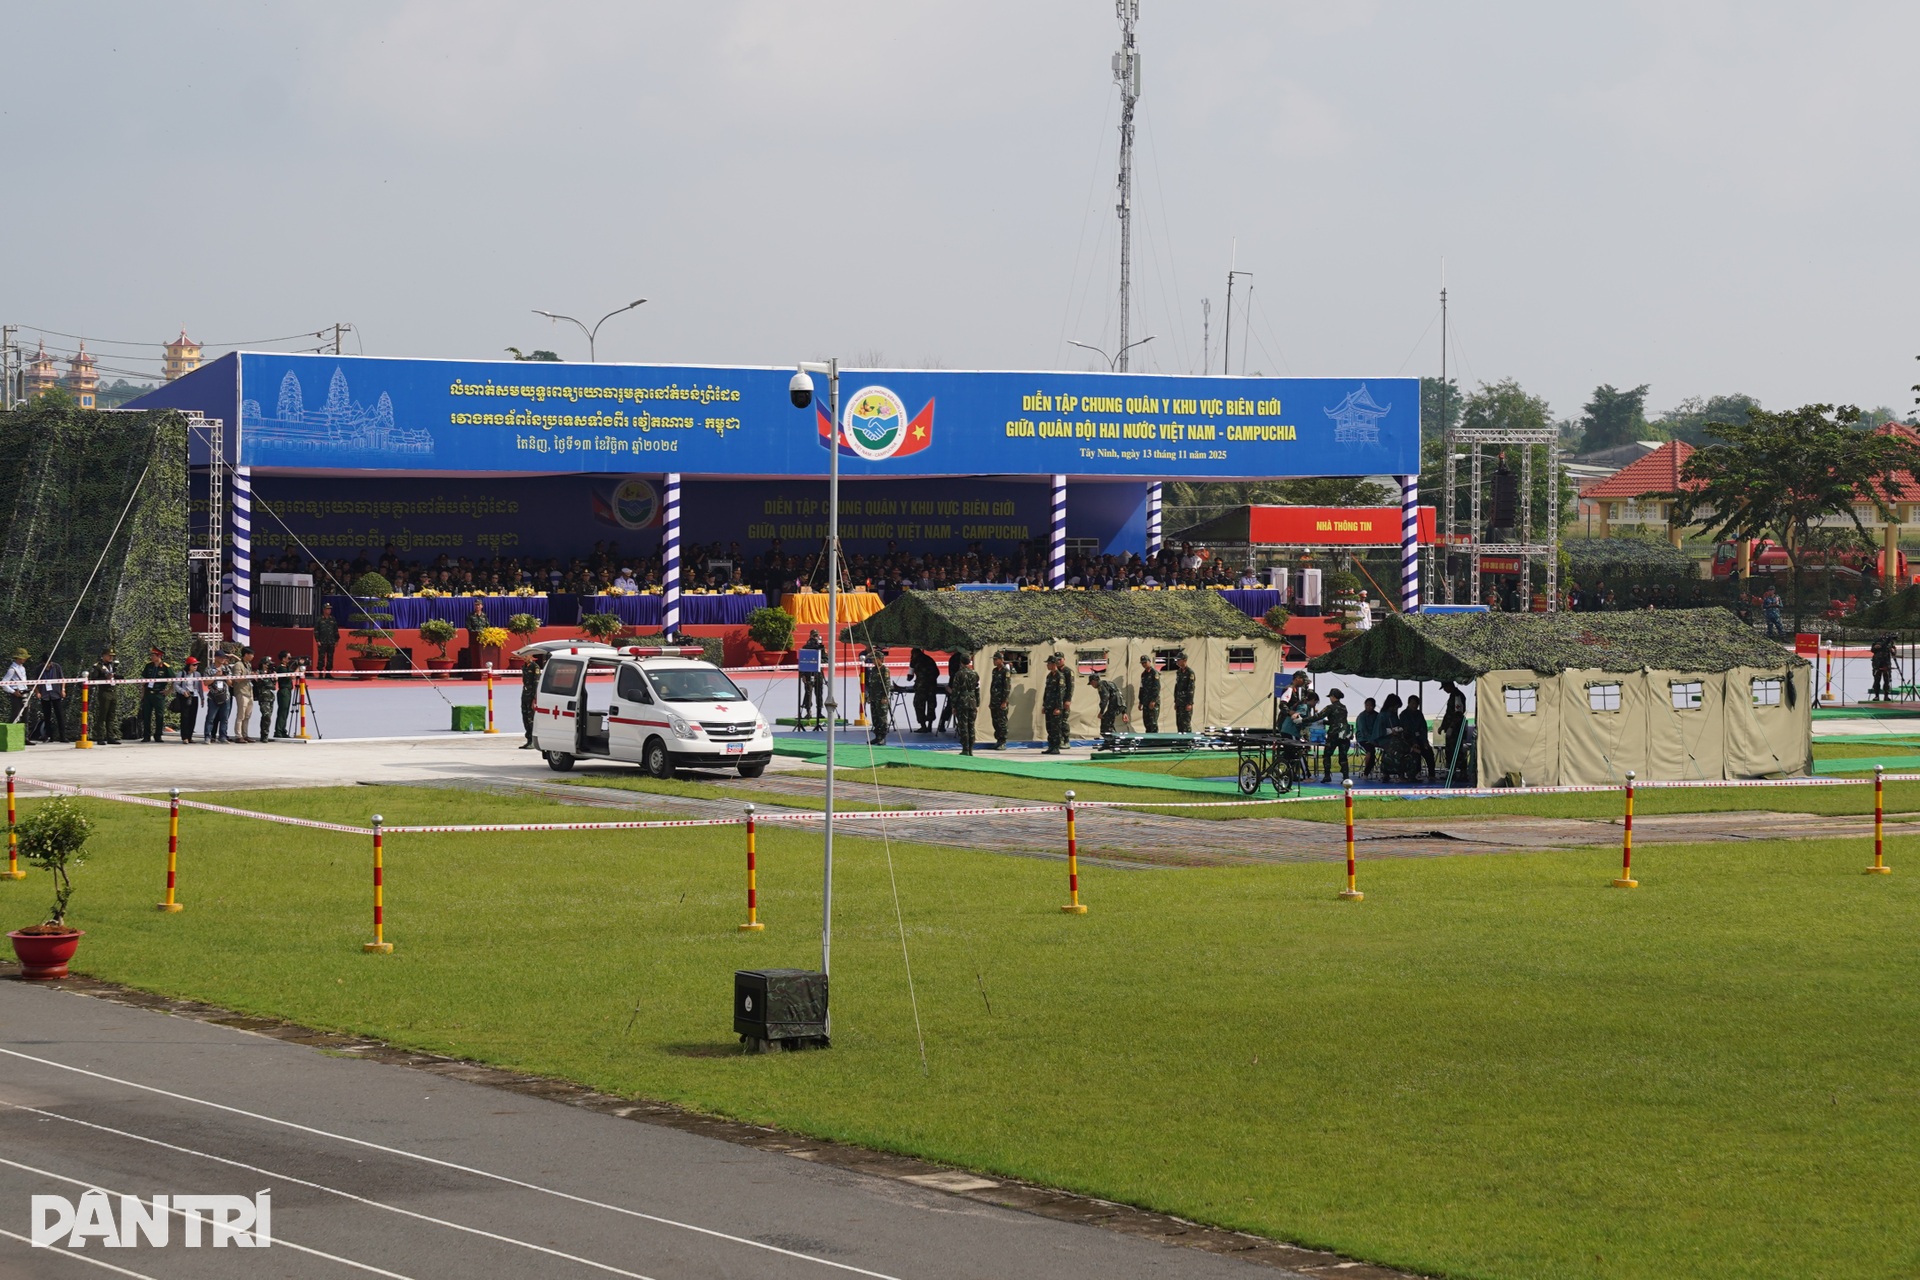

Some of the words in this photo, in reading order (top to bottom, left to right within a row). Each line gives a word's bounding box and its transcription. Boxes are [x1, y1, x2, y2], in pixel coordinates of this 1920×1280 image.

[1022, 390, 1052, 412] DIỄN
[1055, 393, 1078, 414] TẬP
[1081, 397, 1123, 414] CHUNG
[1126, 395, 1159, 415] QUÂN
[1161, 398, 1170, 414] Y
[1172, 399, 1197, 415] KHU
[1200, 397, 1223, 417] VỰC
[1227, 397, 1254, 416] BIÊN
[1257, 398, 1281, 416] GIỚI
[1006, 418, 1035, 437] GIỮA
[1038, 420, 1072, 439] QUÂN
[1075, 420, 1096, 441] ĐỘI
[1099, 423, 1120, 439] HAI
[1122, 420, 1156, 440] NƯỚC
[1159, 420, 1184, 443] VIỆT
[1187, 424, 1216, 441] NAM
[1226, 425, 1297, 441] CAMPUCHIA
[1079, 447, 1096, 460] Tây
[1097, 448, 1120, 461] Ninh,
[1121, 449, 1140, 461] ngày
[1143, 449, 1152, 459] 13
[1153, 449, 1177, 462] tháng
[1178, 450, 1187, 459] 11
[1189, 449, 1207, 460] năm
[1208, 450, 1227, 460] 2025
[764, 496, 793, 515] DIỄN
[796, 498, 818, 518] TẬP
[821, 500, 862, 515] CUNG
[865, 497, 897, 517] QUÂN
[900, 501, 908, 515] Y
[910, 501, 934, 515] KHU
[937, 499, 959, 518] VỰC
[962, 498, 989, 516] BIÊN
[992, 500, 1015, 516] GIỚI
[748, 521, 777, 538] GIỮA
[779, 521, 812, 540] QUÂN
[839, 524, 858, 539] HAI
[862, 521, 894, 539] NƯỚC
[897, 521, 921, 542] VIỆT
[924, 525, 951, 539] NAM
[962, 525, 1029, 540] CAMPUCHIA
[1316, 519, 1333, 532] NHÀ
[1333, 519, 1359, 532] THÔNG
[1359, 520, 1372, 532] TIN
